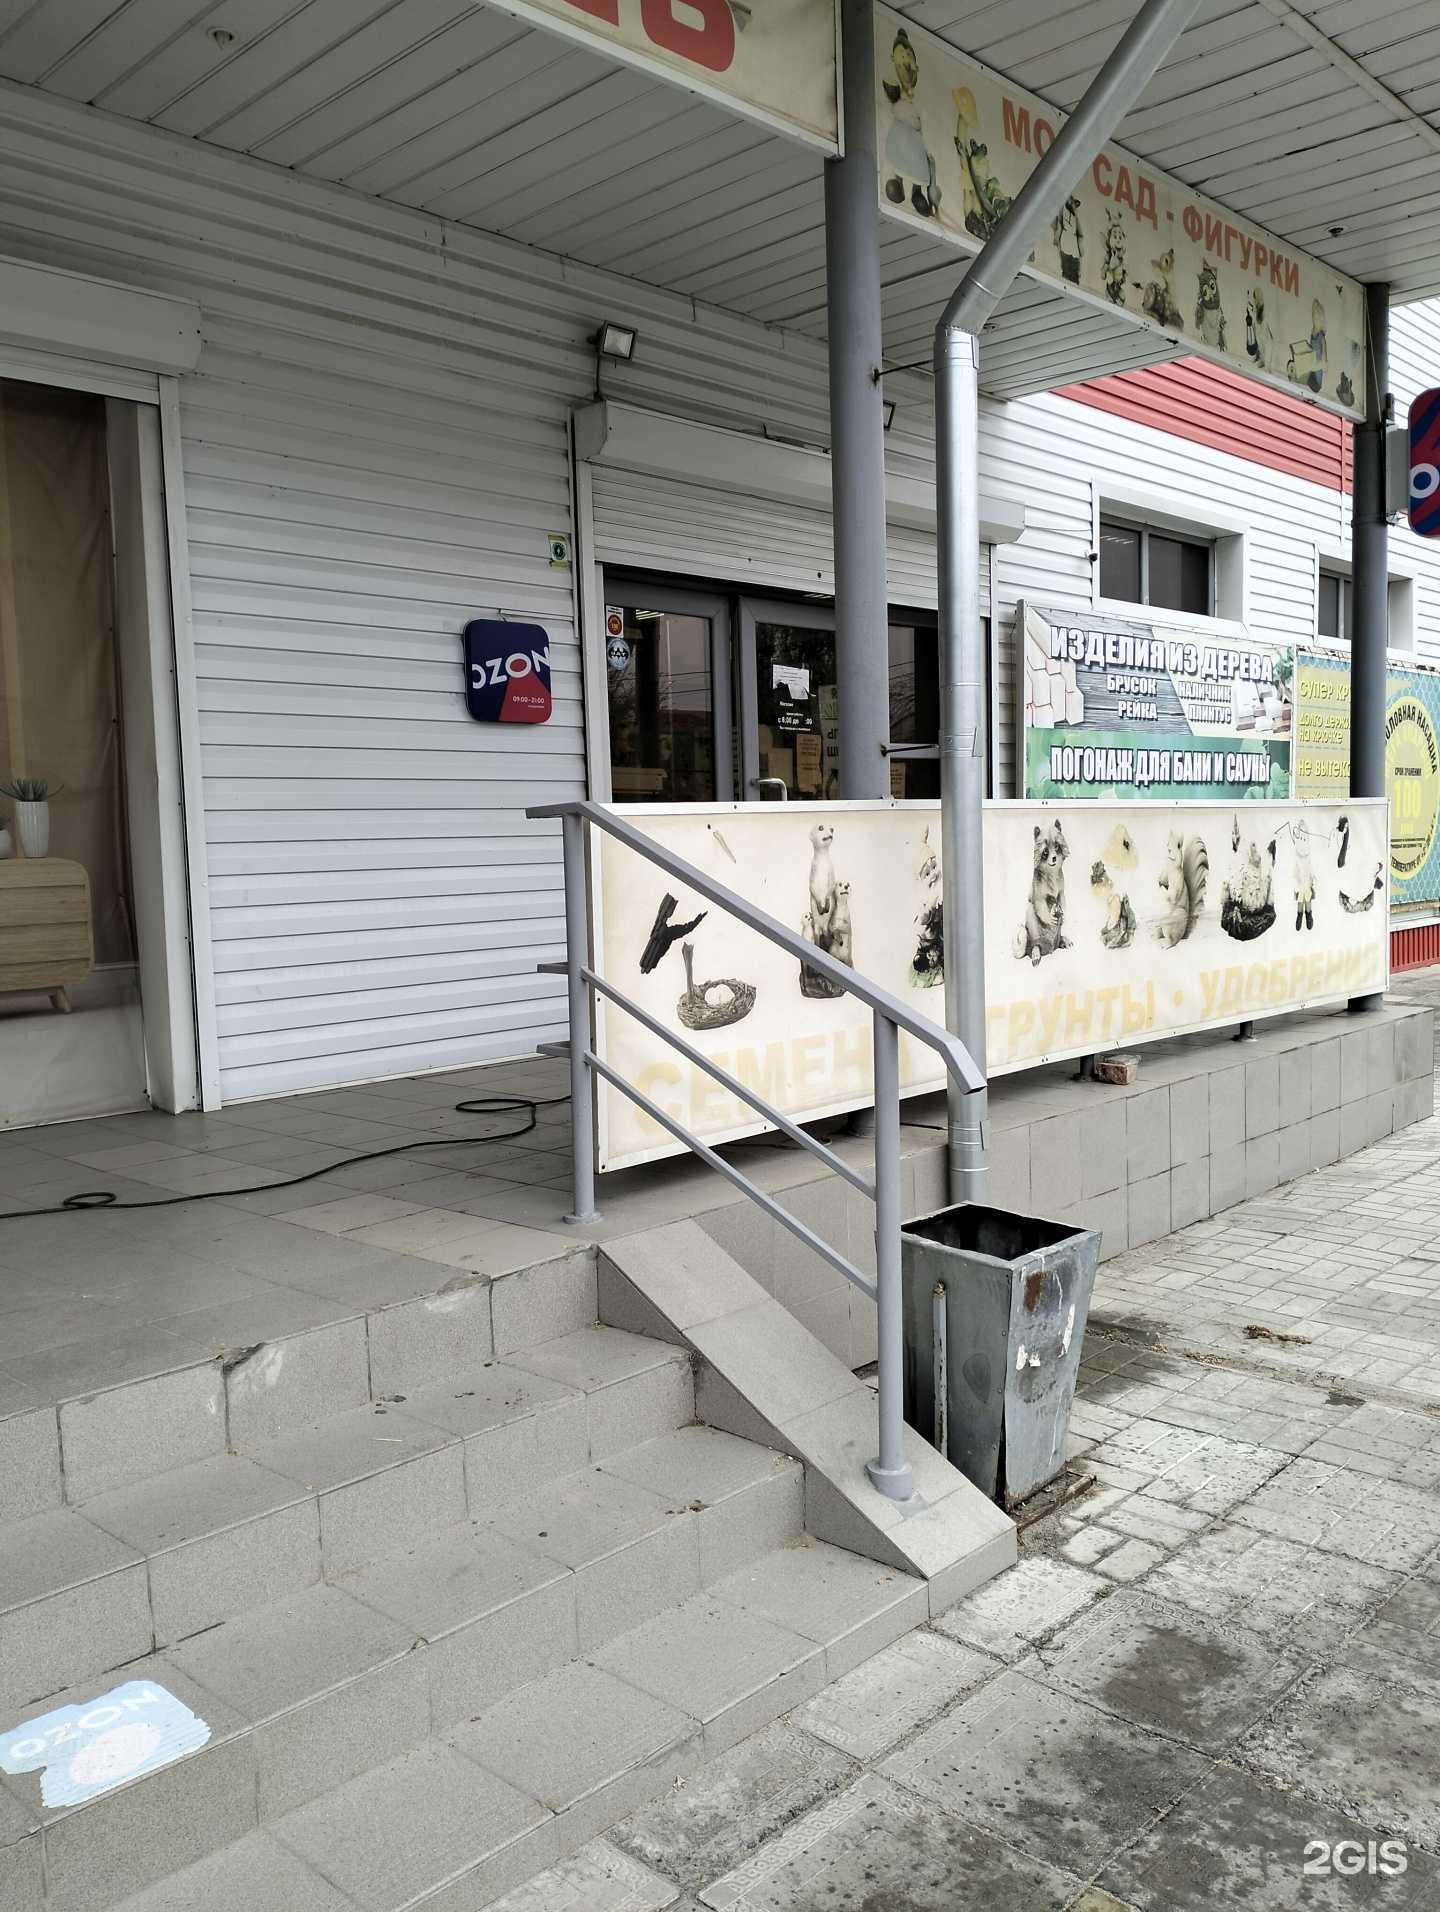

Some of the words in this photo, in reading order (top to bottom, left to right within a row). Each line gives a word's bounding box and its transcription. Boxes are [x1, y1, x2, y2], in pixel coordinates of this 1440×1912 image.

[1002, 96, 1056, 160] МО
[1092, 153, 1159, 230] САД
[1183, 203, 1301, 297] ФИГУРКИ
[1050, 626, 1166, 671] ИЗДЕЛИЯ
[1168, 641, 1199, 673] ИЗ
[1201, 647, 1273, 682] ДЕРЕВА
[1106, 674, 1157, 695] БРУСОК
[1177, 681, 1232, 703] НАЛИЧНИК
[1117, 700, 1158, 720] РЕЙКА
[1187, 703, 1232, 724] ПЛИНТУС
[1416, 709, 1438, 775] НАСАДКА
[1051, 746, 1133, 782] ПОГОНАЖ
[1136, 749, 1170, 787] ДЛЯ
[1173, 751, 1212, 782] БАНИ
[1214, 752, 1224, 782] И
[1225, 753, 1271, 783] САУНЫ
[1198, 942, 1380, 1018] УДОБРЕНИЯ
